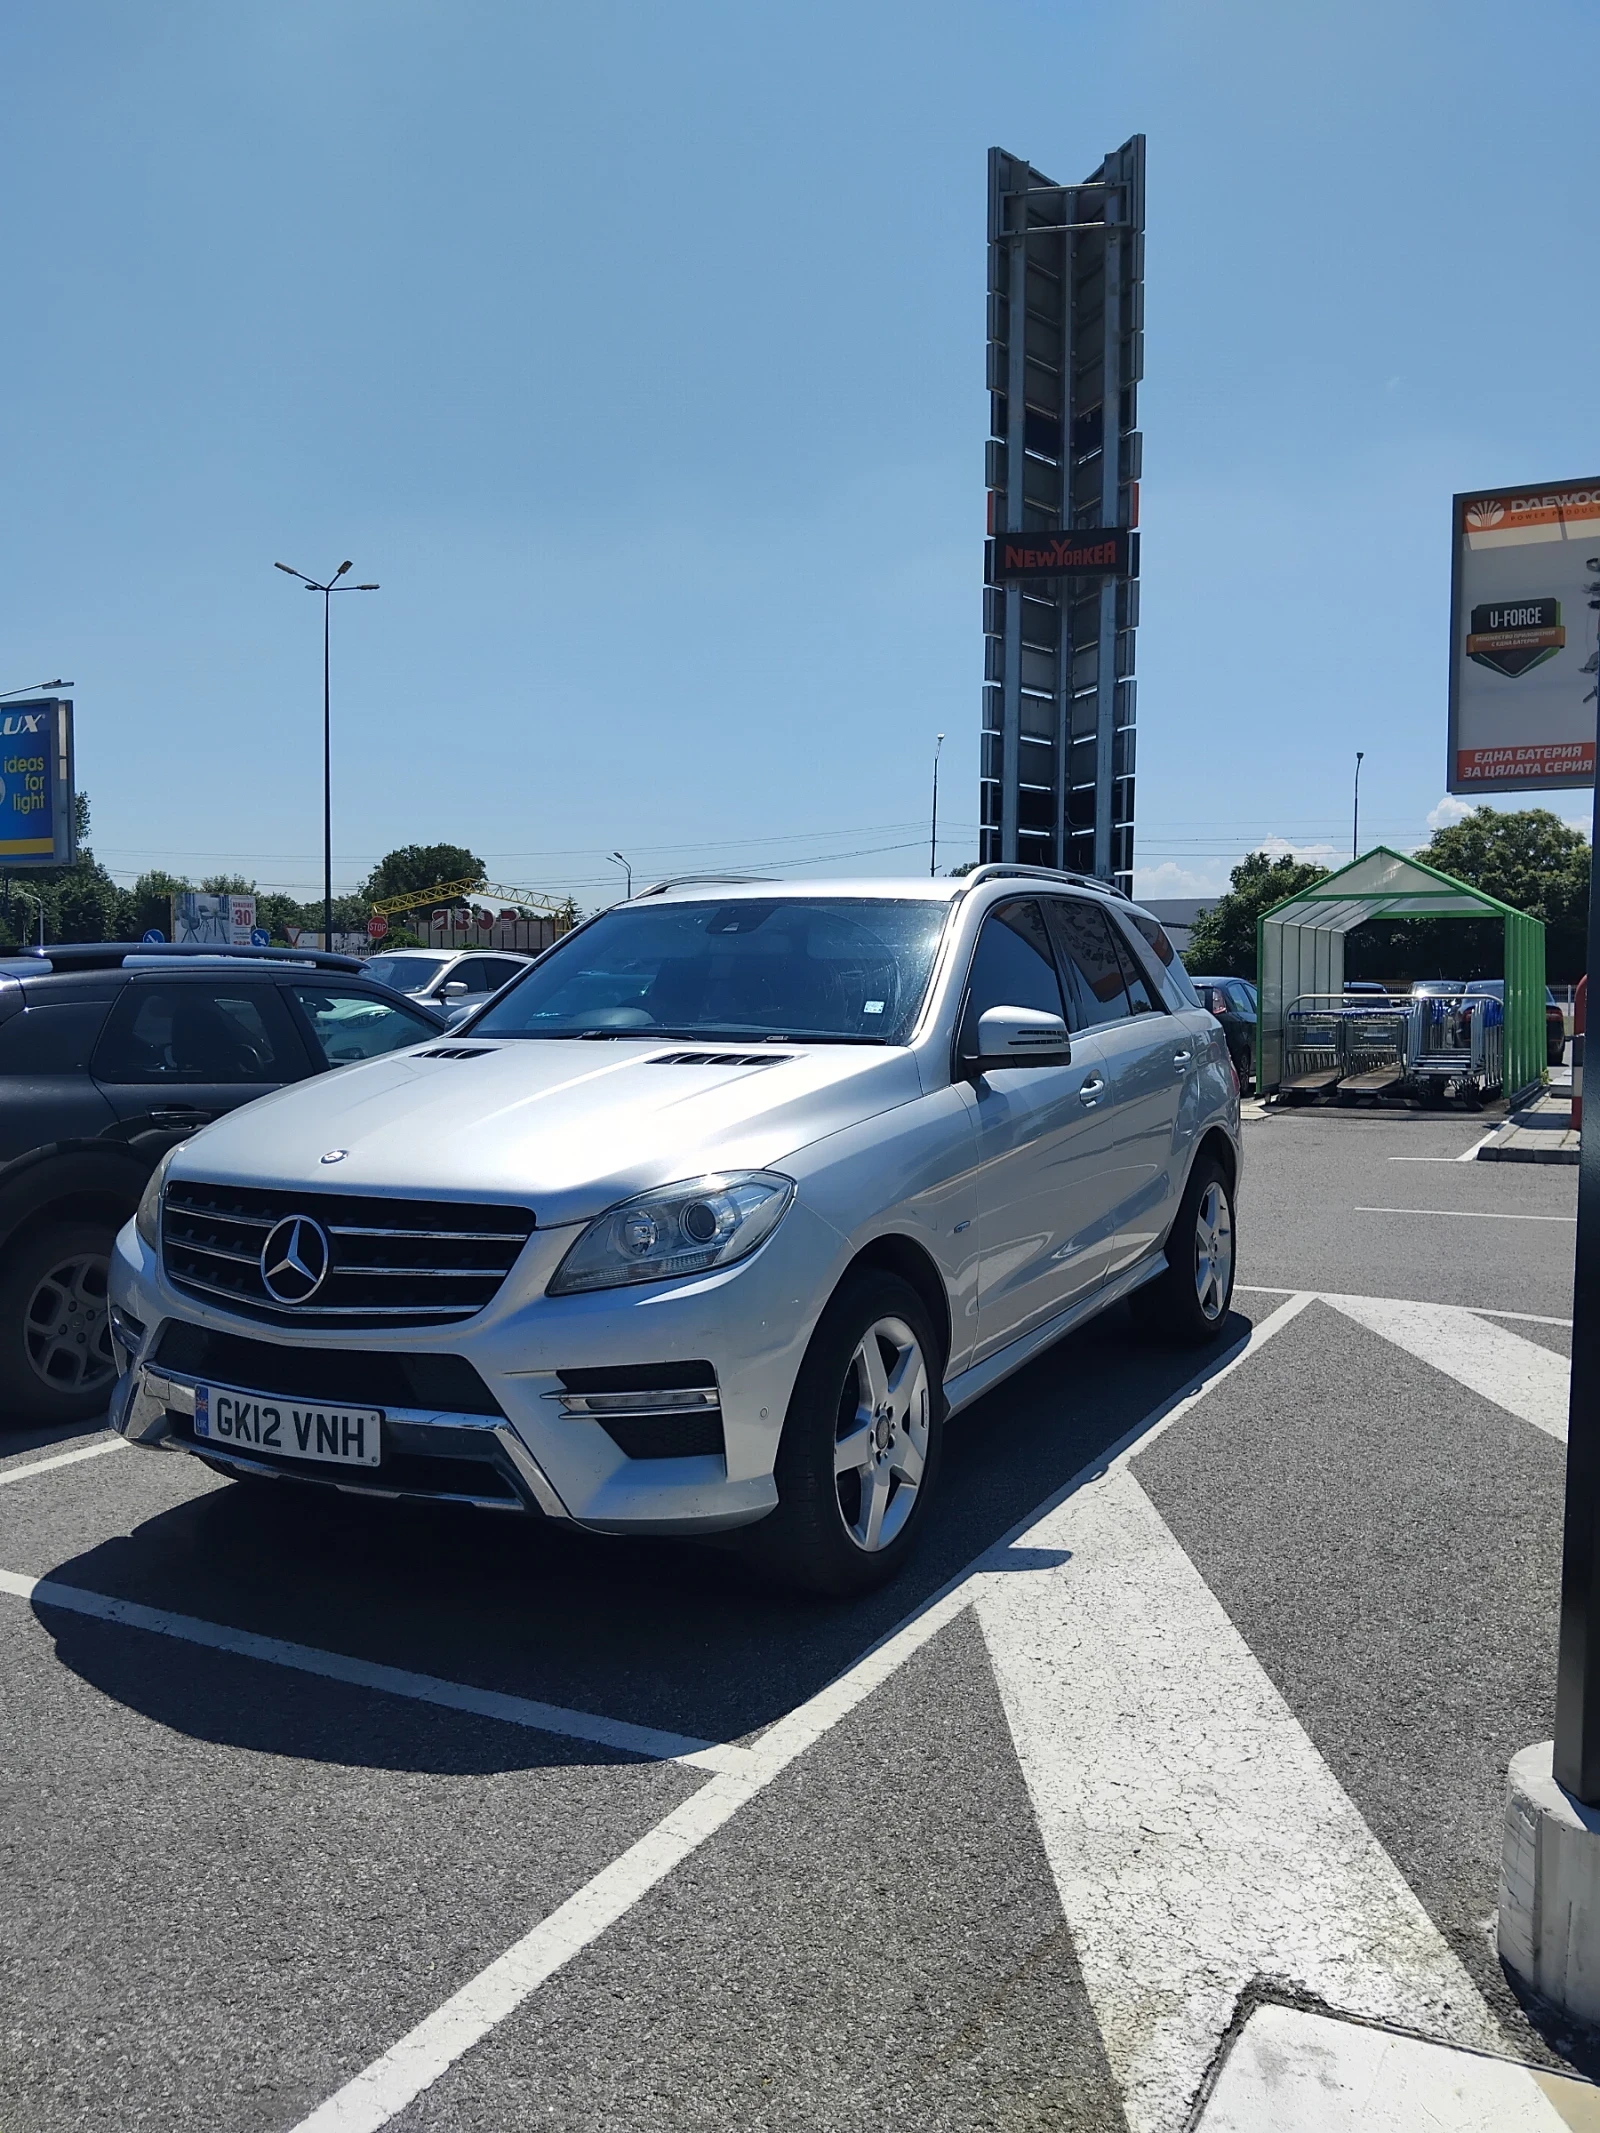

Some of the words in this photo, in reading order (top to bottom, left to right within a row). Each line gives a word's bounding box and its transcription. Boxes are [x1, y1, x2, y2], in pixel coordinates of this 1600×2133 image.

[1511, 512, 1545, 521] POWER
[1490, 607, 1542, 628] U-FORCE
[1474, 750, 1513, 764] ЕДНА
[1516, 746, 1582, 760] БАТЕРИЯ
[4, 755, 44, 774] ideas
[1463, 767, 1481, 778] ЗА
[1484, 763, 1541, 778] ЦЯЛАТА
[1545, 760, 1593, 773] СЕРИЯ
[25, 773, 44, 791] for
[13, 792, 45, 815] light
[369, 922, 387, 932] STOP
[217, 1397, 281, 1448] GK12
[292, 1410, 365, 1458] VNH
